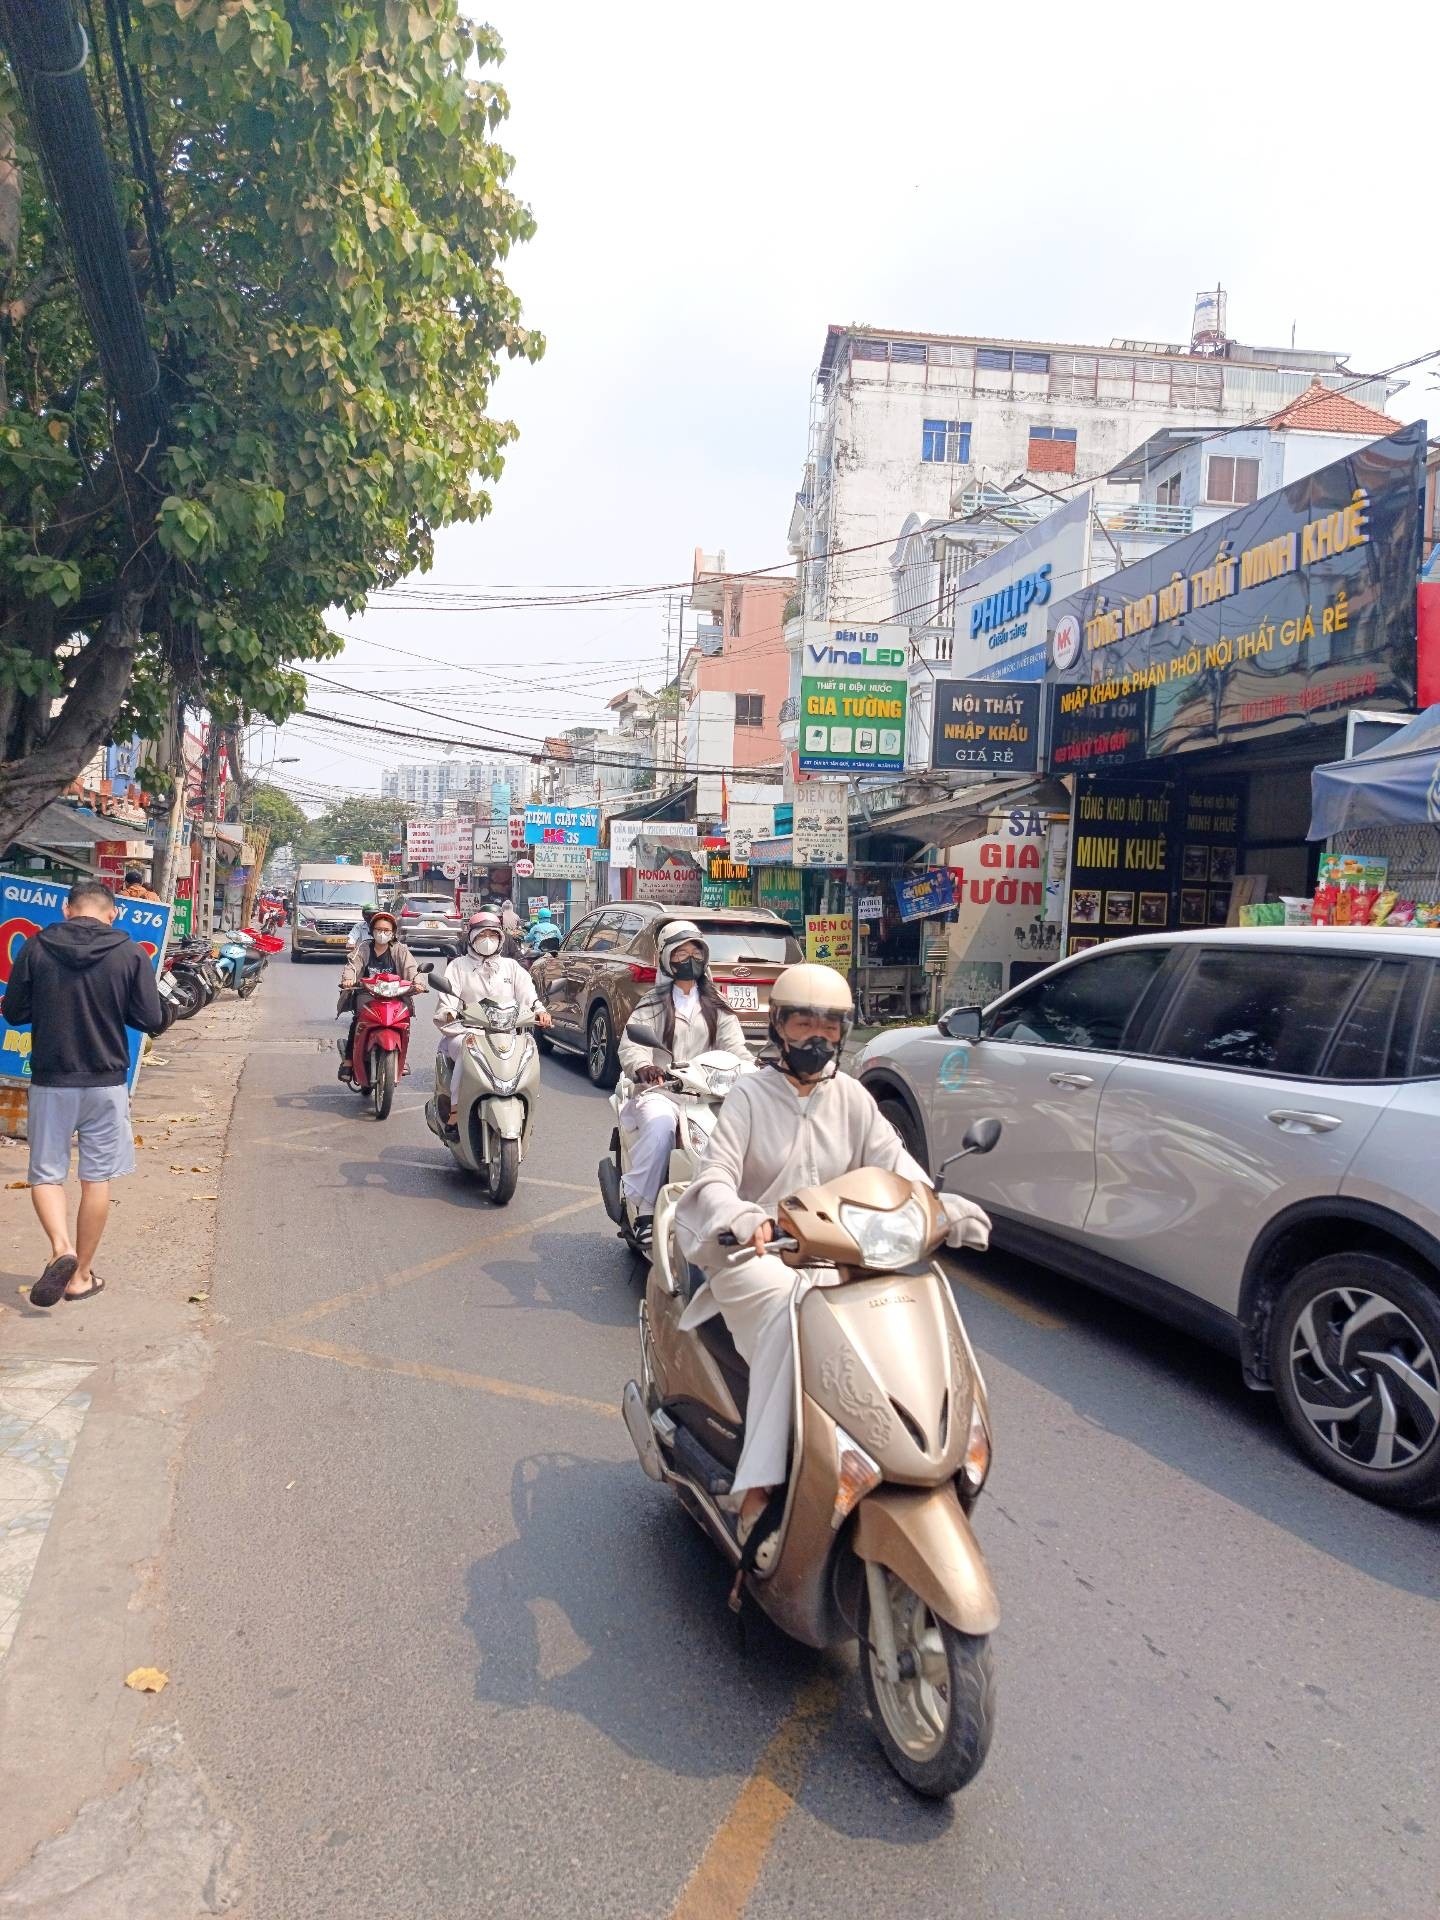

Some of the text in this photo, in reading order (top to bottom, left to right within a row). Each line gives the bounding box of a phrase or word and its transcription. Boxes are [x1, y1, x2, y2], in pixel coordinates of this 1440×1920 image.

[1124, 594, 1156, 638] KHO
[1159, 572, 1190, 626] NỘI
[1192, 541, 1239, 608] THẤT
[1242, 532, 1298, 590] MINH
[970, 563, 1053, 640] PHILIPS
[860, 633, 879, 643] LED
[807, 645, 905, 667] VinaLED
[1061, 592, 1349, 714] NHẬP KHẨU & PHÂN PHỐI NỘI THẤT GIÁ RẺ
[816, 681, 836, 691] THIẾT
[807, 694, 903, 719] GIA TƯỜNG
[952, 692, 1024, 716] NỘI THẤT
[944, 718, 1029, 742] NHẬP KHẨU
[956, 746, 1014, 763] GIÁ RẺ
[1080, 785, 1170, 826] TỔNG KHO NỘI THẤT
[526, 809, 552, 826] TIỆM
[580, 810, 597, 827] SẤY
[980, 844, 1040, 868] GIA
[1077, 832, 1168, 870] MINH KHUÊ
[639, 870, 671, 880] HONDA
[711, 855, 722, 878] HỚT
[4, 885, 58, 908] QUÁN
[131, 911, 163, 928] 376
[808, 918, 837, 934] ĐIỆN
[734, 987, 751, 997] 51G
